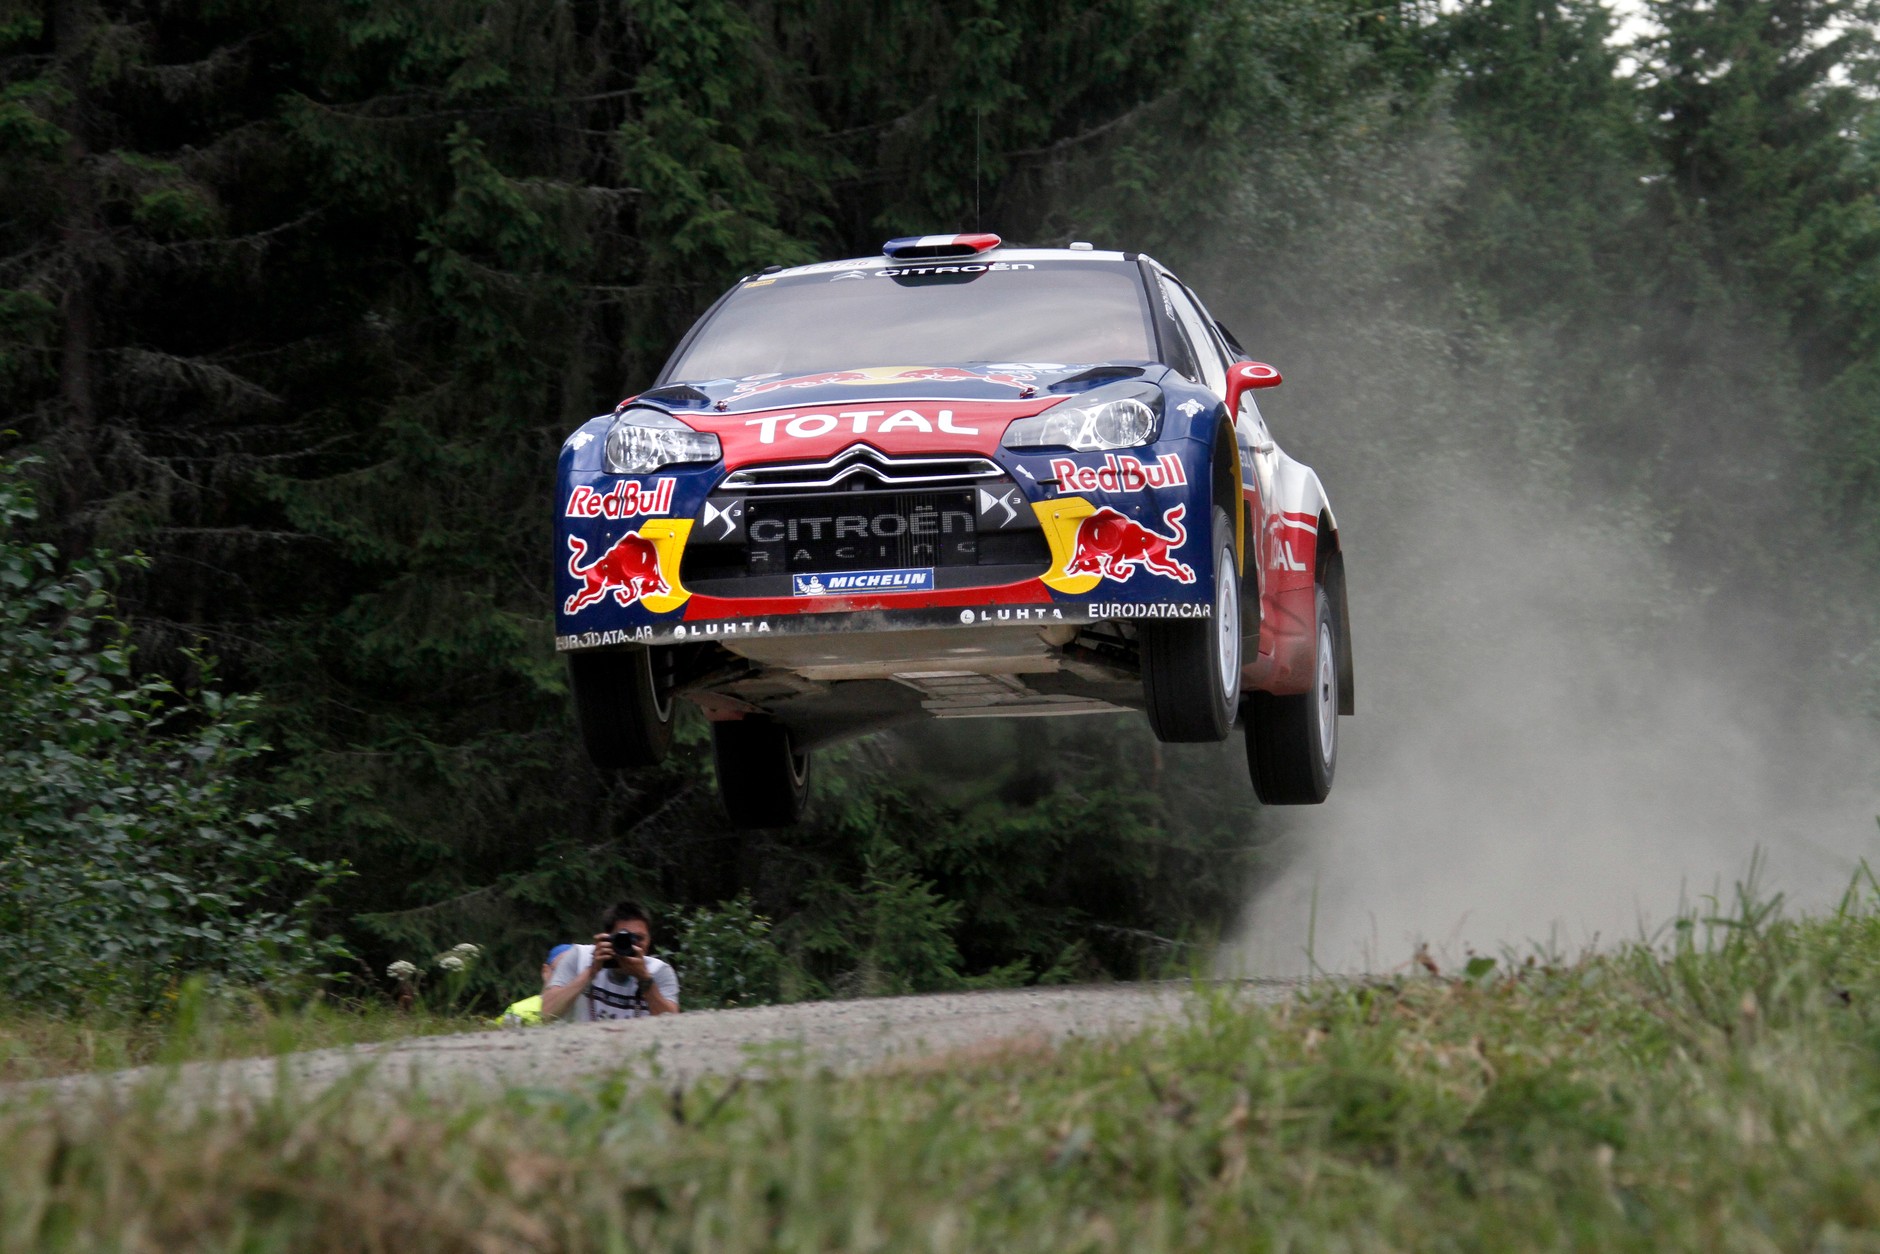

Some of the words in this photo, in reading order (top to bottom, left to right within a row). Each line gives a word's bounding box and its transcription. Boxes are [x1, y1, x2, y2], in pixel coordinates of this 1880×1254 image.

[745, 409, 979, 444] TOTAL
[1050, 453, 1122, 494] Red
[1117, 453, 1188, 492] Bull
[565, 479, 625, 520] Red
[621, 477, 677, 519] Bull
[828, 572, 927, 589] MICHELIN
[981, 608, 1064, 621] LUHTA
[1088, 603, 1212, 618] EURODATACAR
[691, 621, 771, 636] LUHTA
